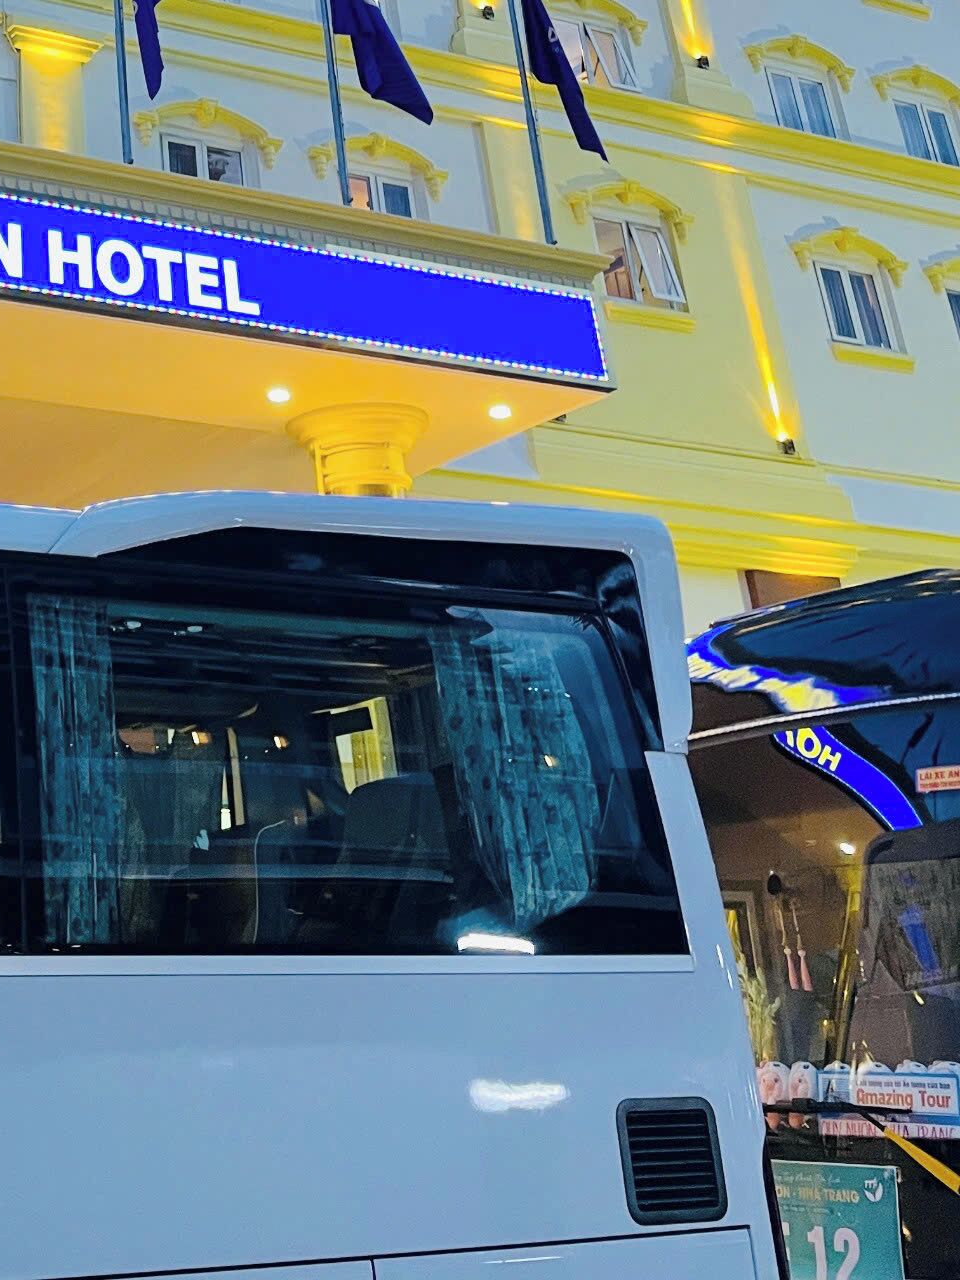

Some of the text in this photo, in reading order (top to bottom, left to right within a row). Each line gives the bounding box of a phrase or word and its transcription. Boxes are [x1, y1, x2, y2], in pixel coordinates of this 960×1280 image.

[47, 230, 261, 316] HOTEL
[918, 1089, 951, 1108] Tour
[806, 1225, 861, 1280] 12
